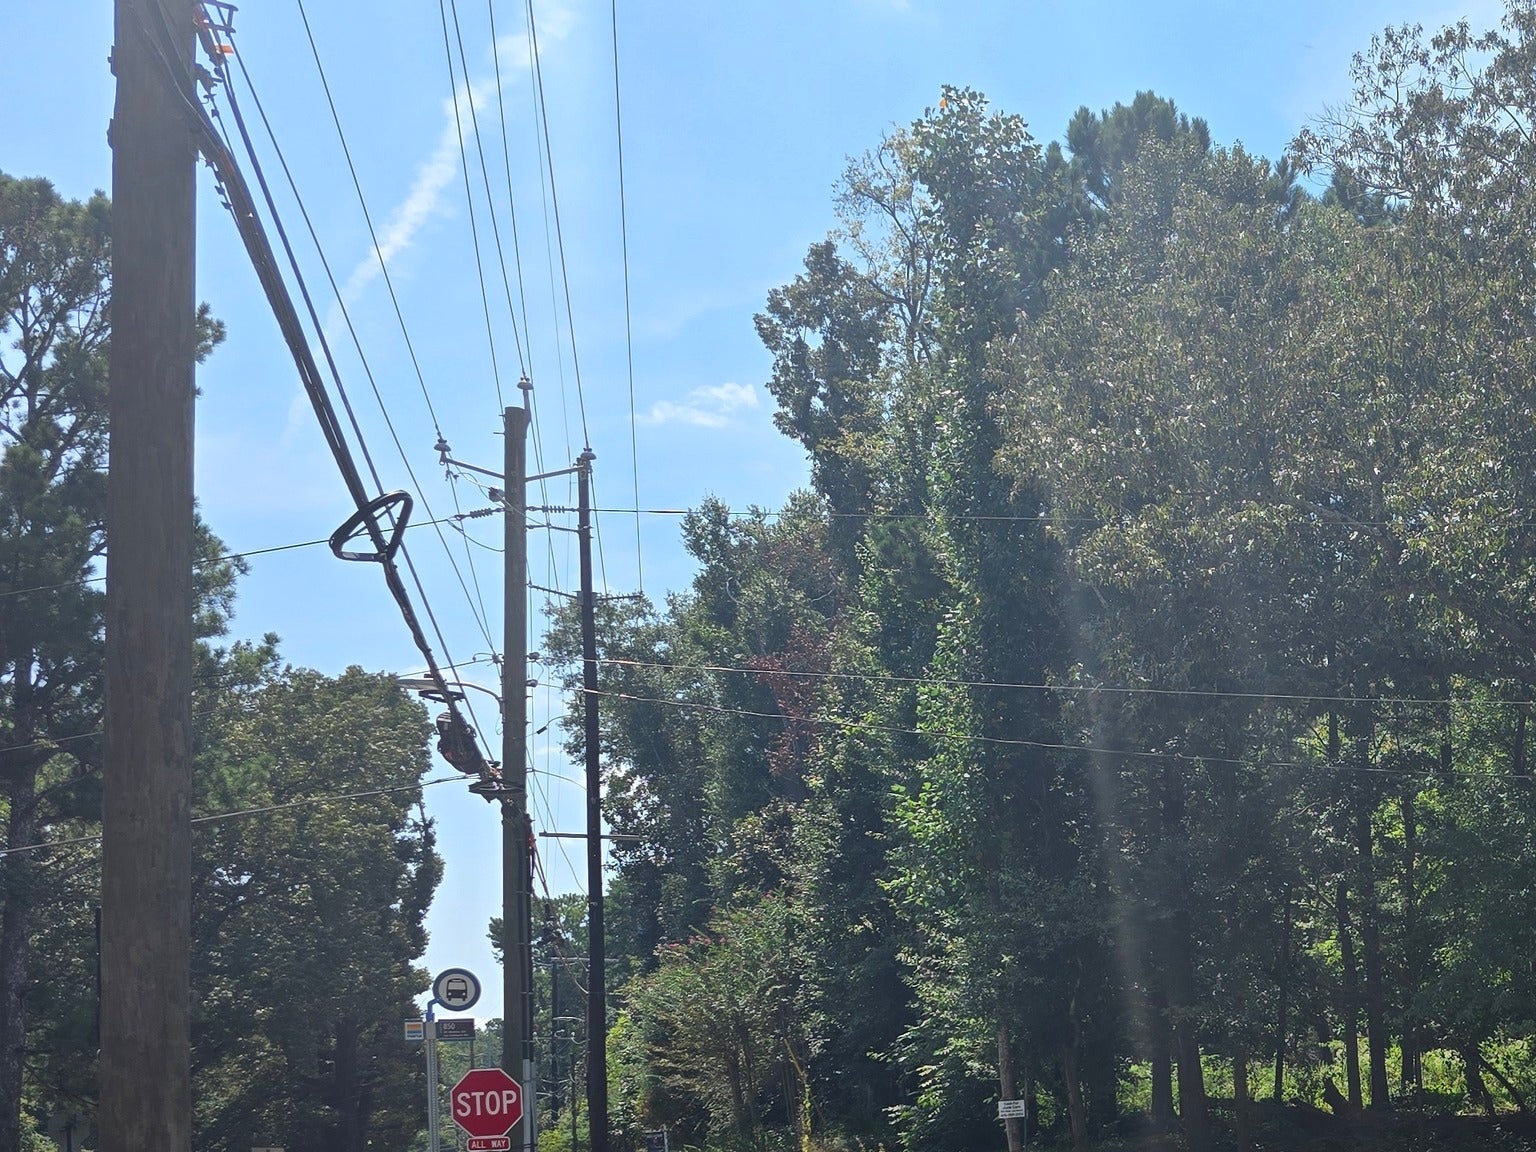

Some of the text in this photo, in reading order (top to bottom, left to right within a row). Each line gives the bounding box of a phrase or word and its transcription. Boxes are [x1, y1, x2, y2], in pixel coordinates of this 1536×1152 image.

[456, 1089, 517, 1118] STOP
[471, 1139, 507, 1149] ALL WAY
